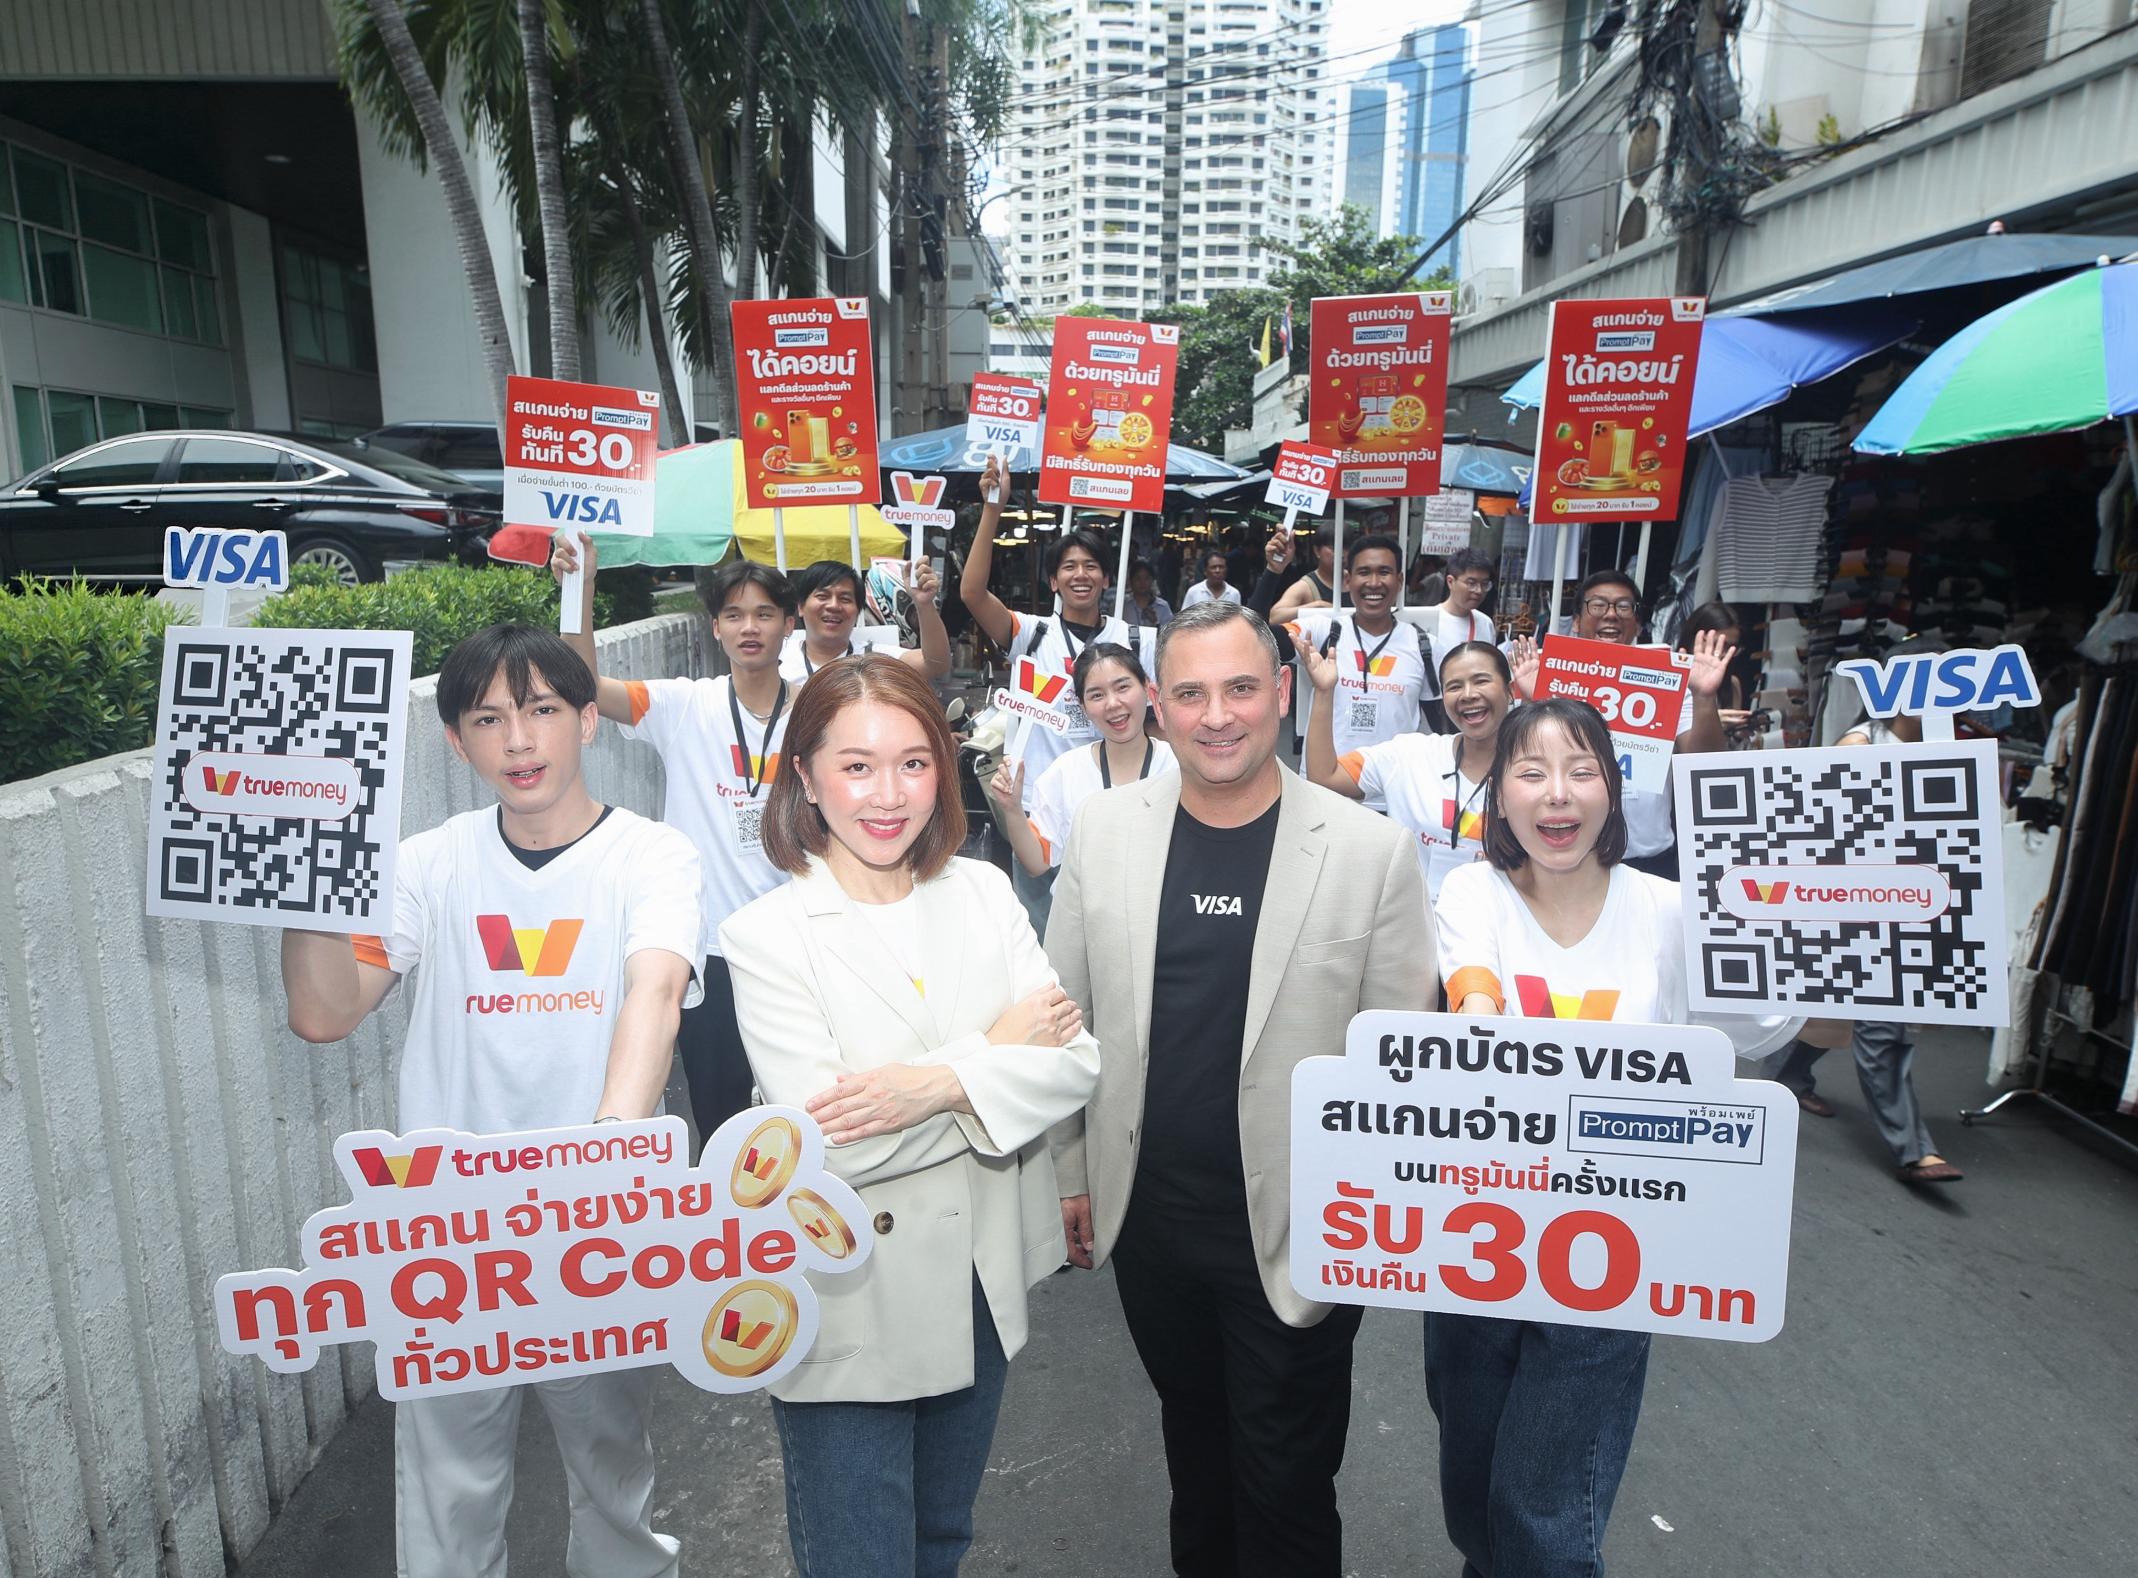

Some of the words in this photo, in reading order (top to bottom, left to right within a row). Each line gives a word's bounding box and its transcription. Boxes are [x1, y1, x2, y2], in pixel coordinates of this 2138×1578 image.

[768, 308, 832, 325] สแกนจ่าย
[1347, 305, 1414, 323] สแกนจ่าย
[1592, 309, 1664, 328] สแกนจ่าย
[1086, 330, 1146, 345] สแกนจ่าย
[746, 348, 858, 378] ได้คอยน์
[1326, 340, 1433, 371] ด้วยทรูมันนี่
[1064, 361, 1161, 387] ด้วยทรูมันนี่
[1562, 353, 1684, 386] ได้คอยน์
[513, 400, 588, 420] สแกนจ่าย
[595, 411, 649, 427] PromptPay
[522, 424, 564, 442] รับคืน
[984, 425, 1021, 443] VISA
[521, 441, 564, 464] ทันที
[1089, 485, 1129, 496] สแกนเลย
[1361, 475, 1404, 484] สแกนเลย
[538, 491, 622, 525] VISA
[1282, 490, 1312, 508] VISA
[1596, 501, 1608, 509] 20
[885, 509, 952, 525] truemoney
[170, 531, 281, 585] VISA
[1545, 657, 1617, 678] สแกนจ่าย
[1623, 671, 1679, 687] PromptPay
[1844, 652, 2033, 712] VISA
[1549, 679, 1589, 698] รับคืน
[998, 693, 1066, 731] truemoney
[243, 774, 347, 806] truemoney
[1190, 894, 1242, 916] VISA
[1794, 884, 1931, 908] truemoney
[465, 989, 604, 1014] ruemoney
[1378, 1025, 1565, 1084] ผูกบัตร
[1574, 1046, 1693, 1086] VISA
[1320, 1096, 1557, 1145] สแกนจ่าย
[1580, 1110, 1753, 1149] PromptPay
[1688, 1106, 1756, 1121] พร้อมเพย์
[451, 1131, 673, 1177] truemoney
[1394, 1156, 1687, 1203] บนทรูมันนี่ครั้งแรก
[318, 1208, 490, 1260] สแกน
[505, 1175, 713, 1236] จ่ายง่าย
[1321, 1180, 1424, 1255] รับ
[1438, 1201, 1642, 1312] 30
[1649, 1281, 1756, 1325] บาท
[231, 1276, 368, 1360] ทุก
[389, 1248, 539, 1326] QR
[559, 1217, 797, 1297] Code
[1320, 1259, 1428, 1294] เงินคืน
[393, 1316, 670, 1389] ทั่วประเทศ
